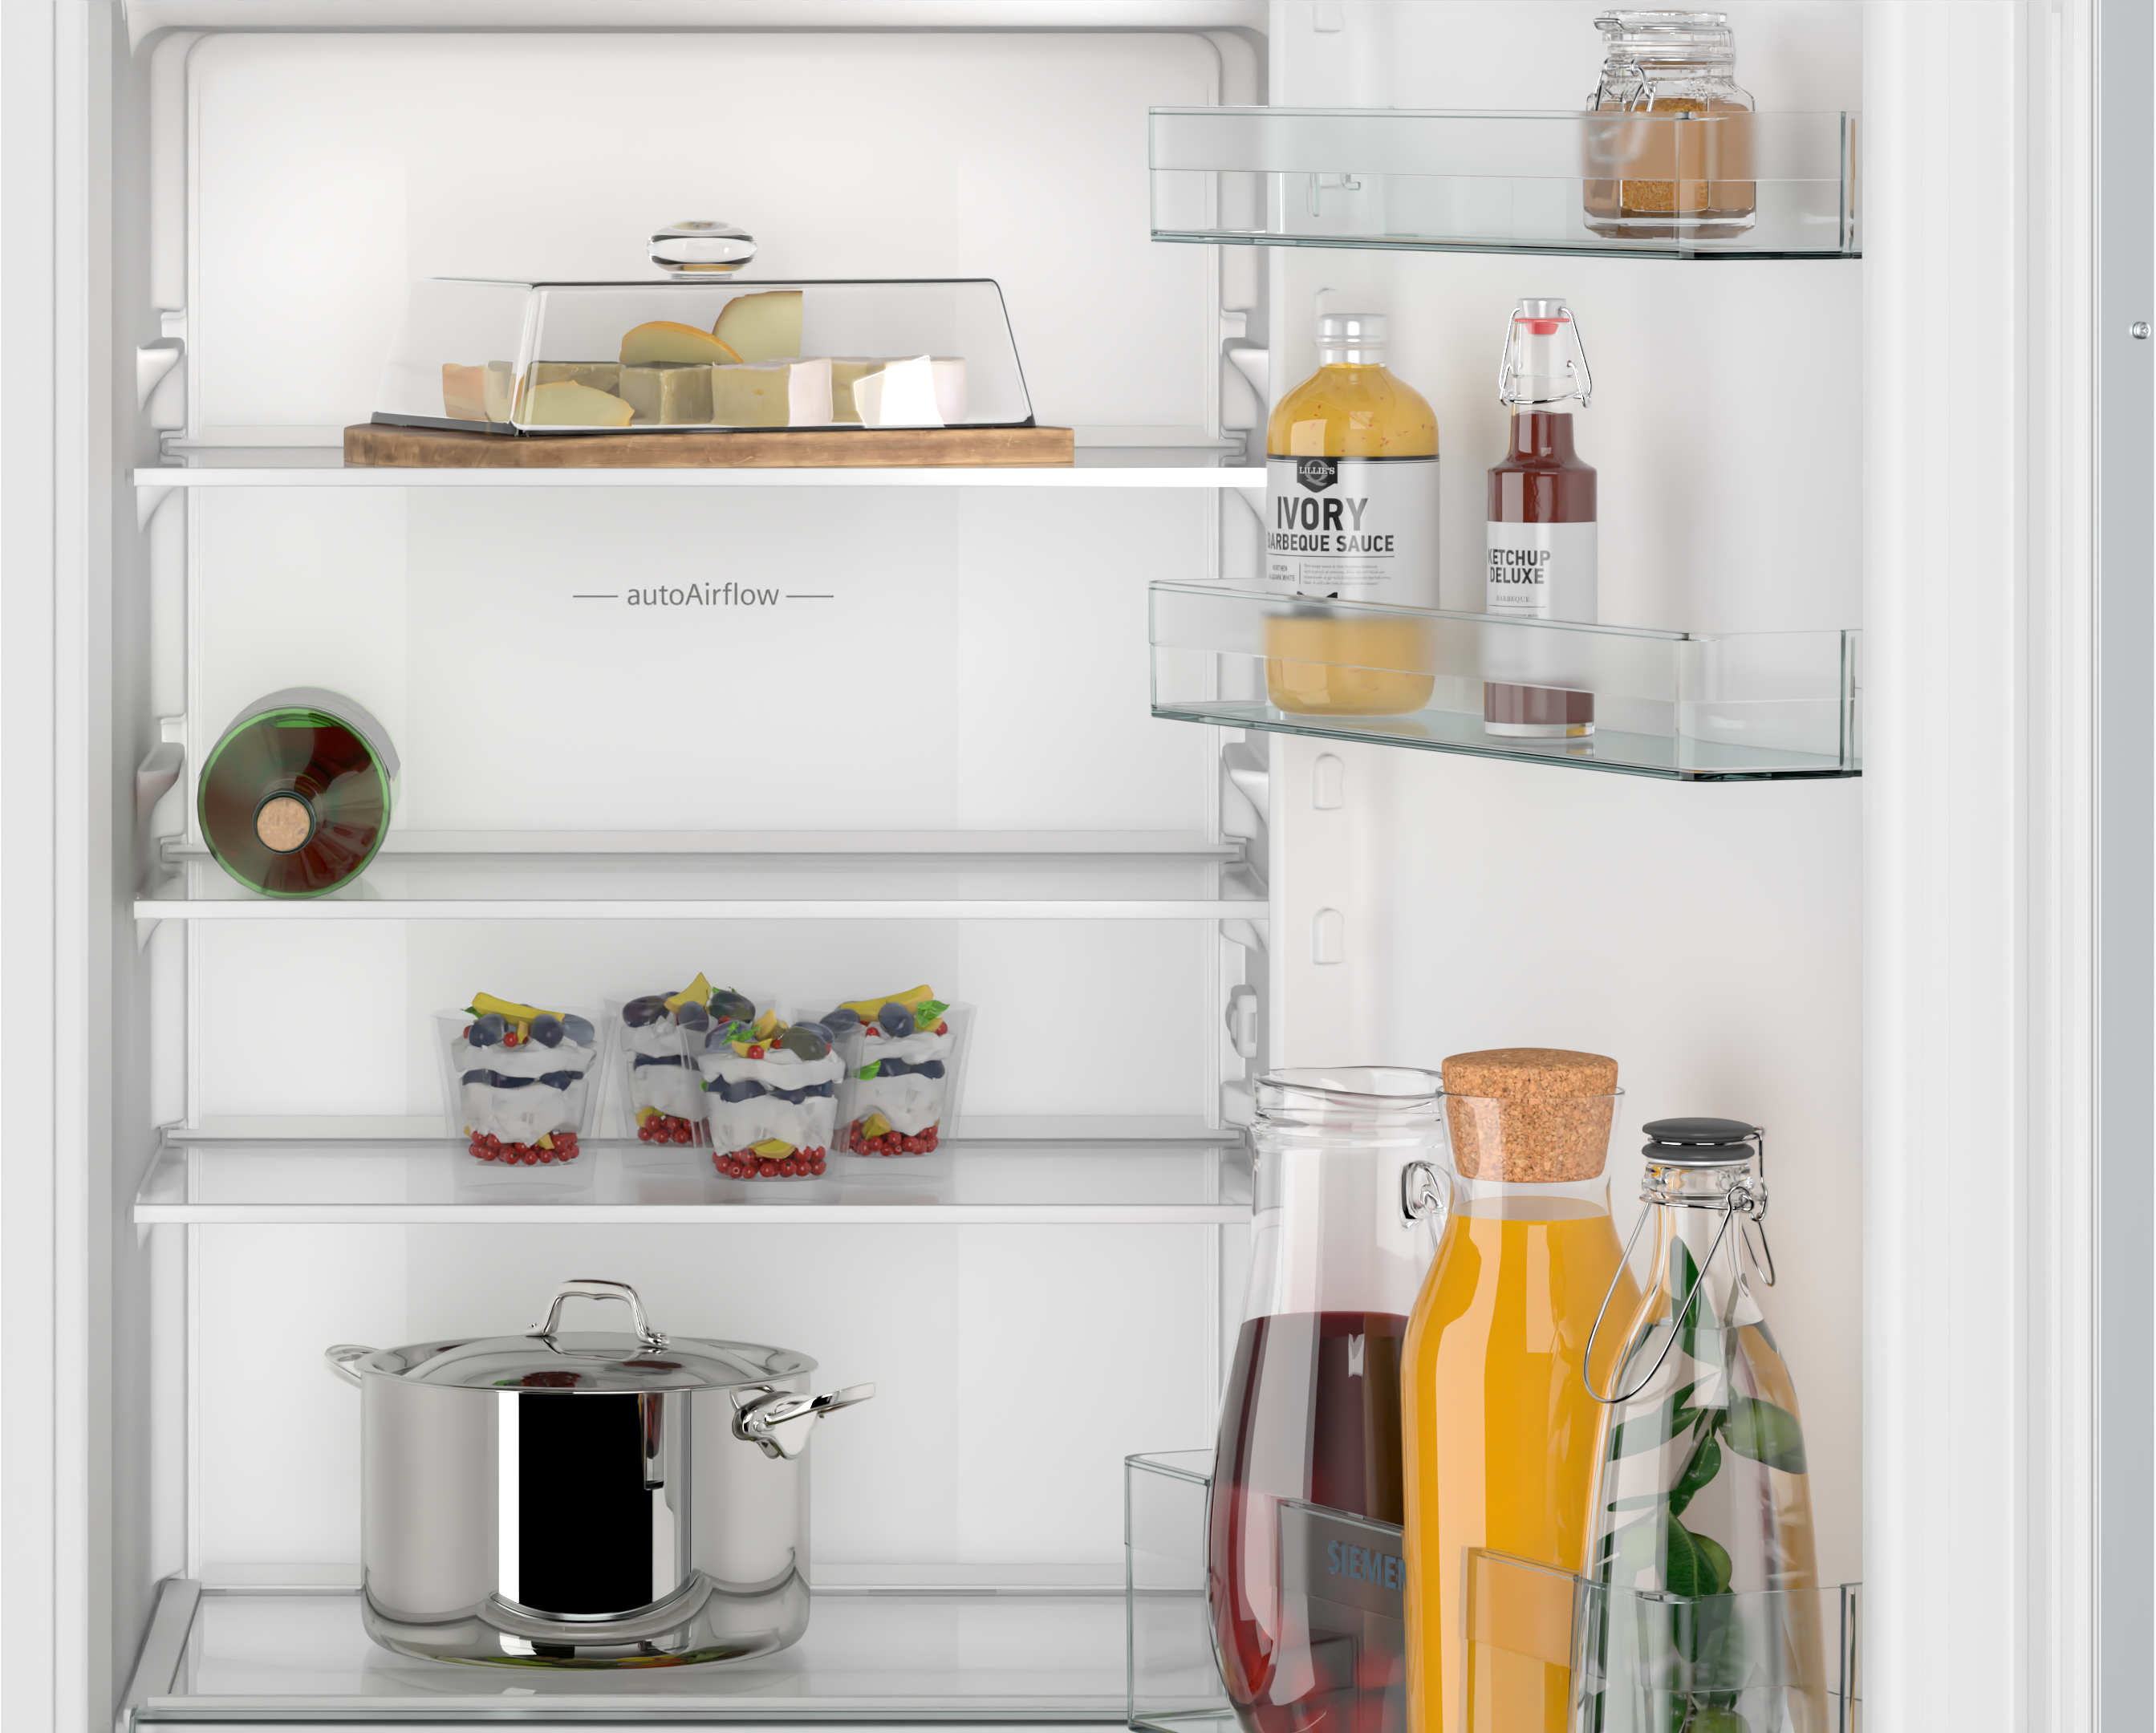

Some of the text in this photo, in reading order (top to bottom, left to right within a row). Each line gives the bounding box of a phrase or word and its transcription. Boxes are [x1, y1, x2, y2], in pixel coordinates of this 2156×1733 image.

[1299, 466, 1335, 475] LILLIE'S
[1277, 496, 1369, 531] IVORY
[1267, 532, 1395, 552] BARBEQUE SAUCE
[1488, 548, 1551, 566] KETCHUP
[1490, 566, 1545, 584] DELUXE
[627, 582, 779, 606] autoAirflow
